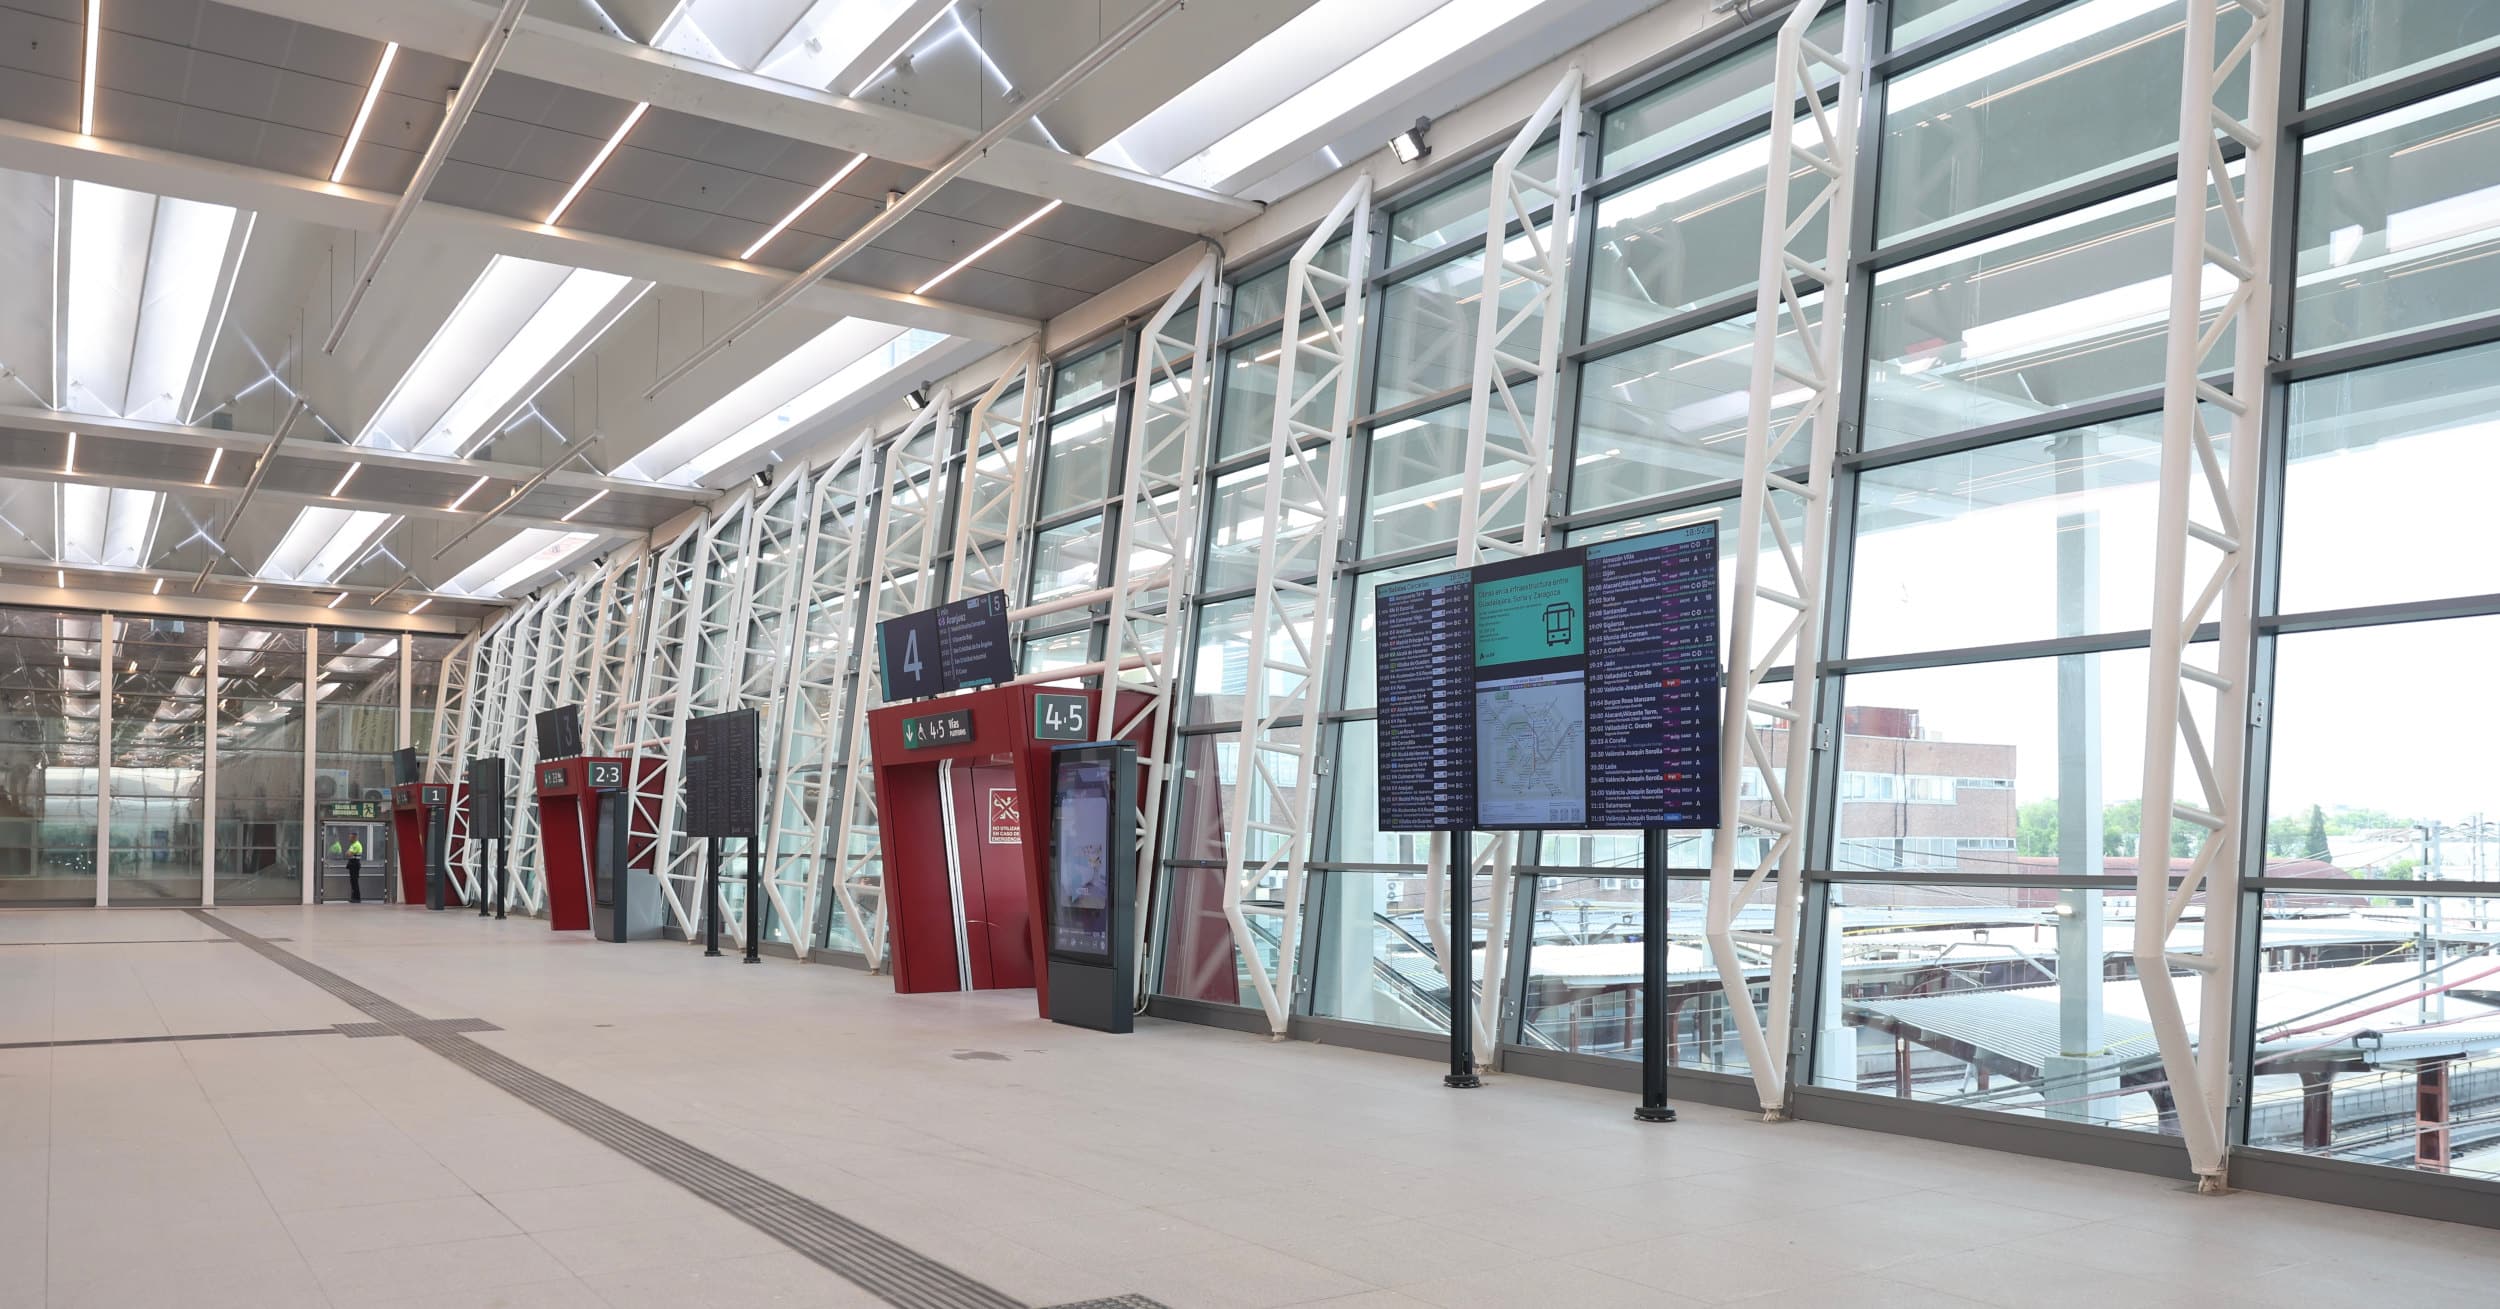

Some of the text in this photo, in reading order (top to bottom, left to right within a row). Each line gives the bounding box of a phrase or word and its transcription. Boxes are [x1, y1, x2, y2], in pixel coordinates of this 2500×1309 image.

[904, 629, 922, 681] 4
[948, 717, 959, 729] Vías
[432, 790, 440, 801] 1
